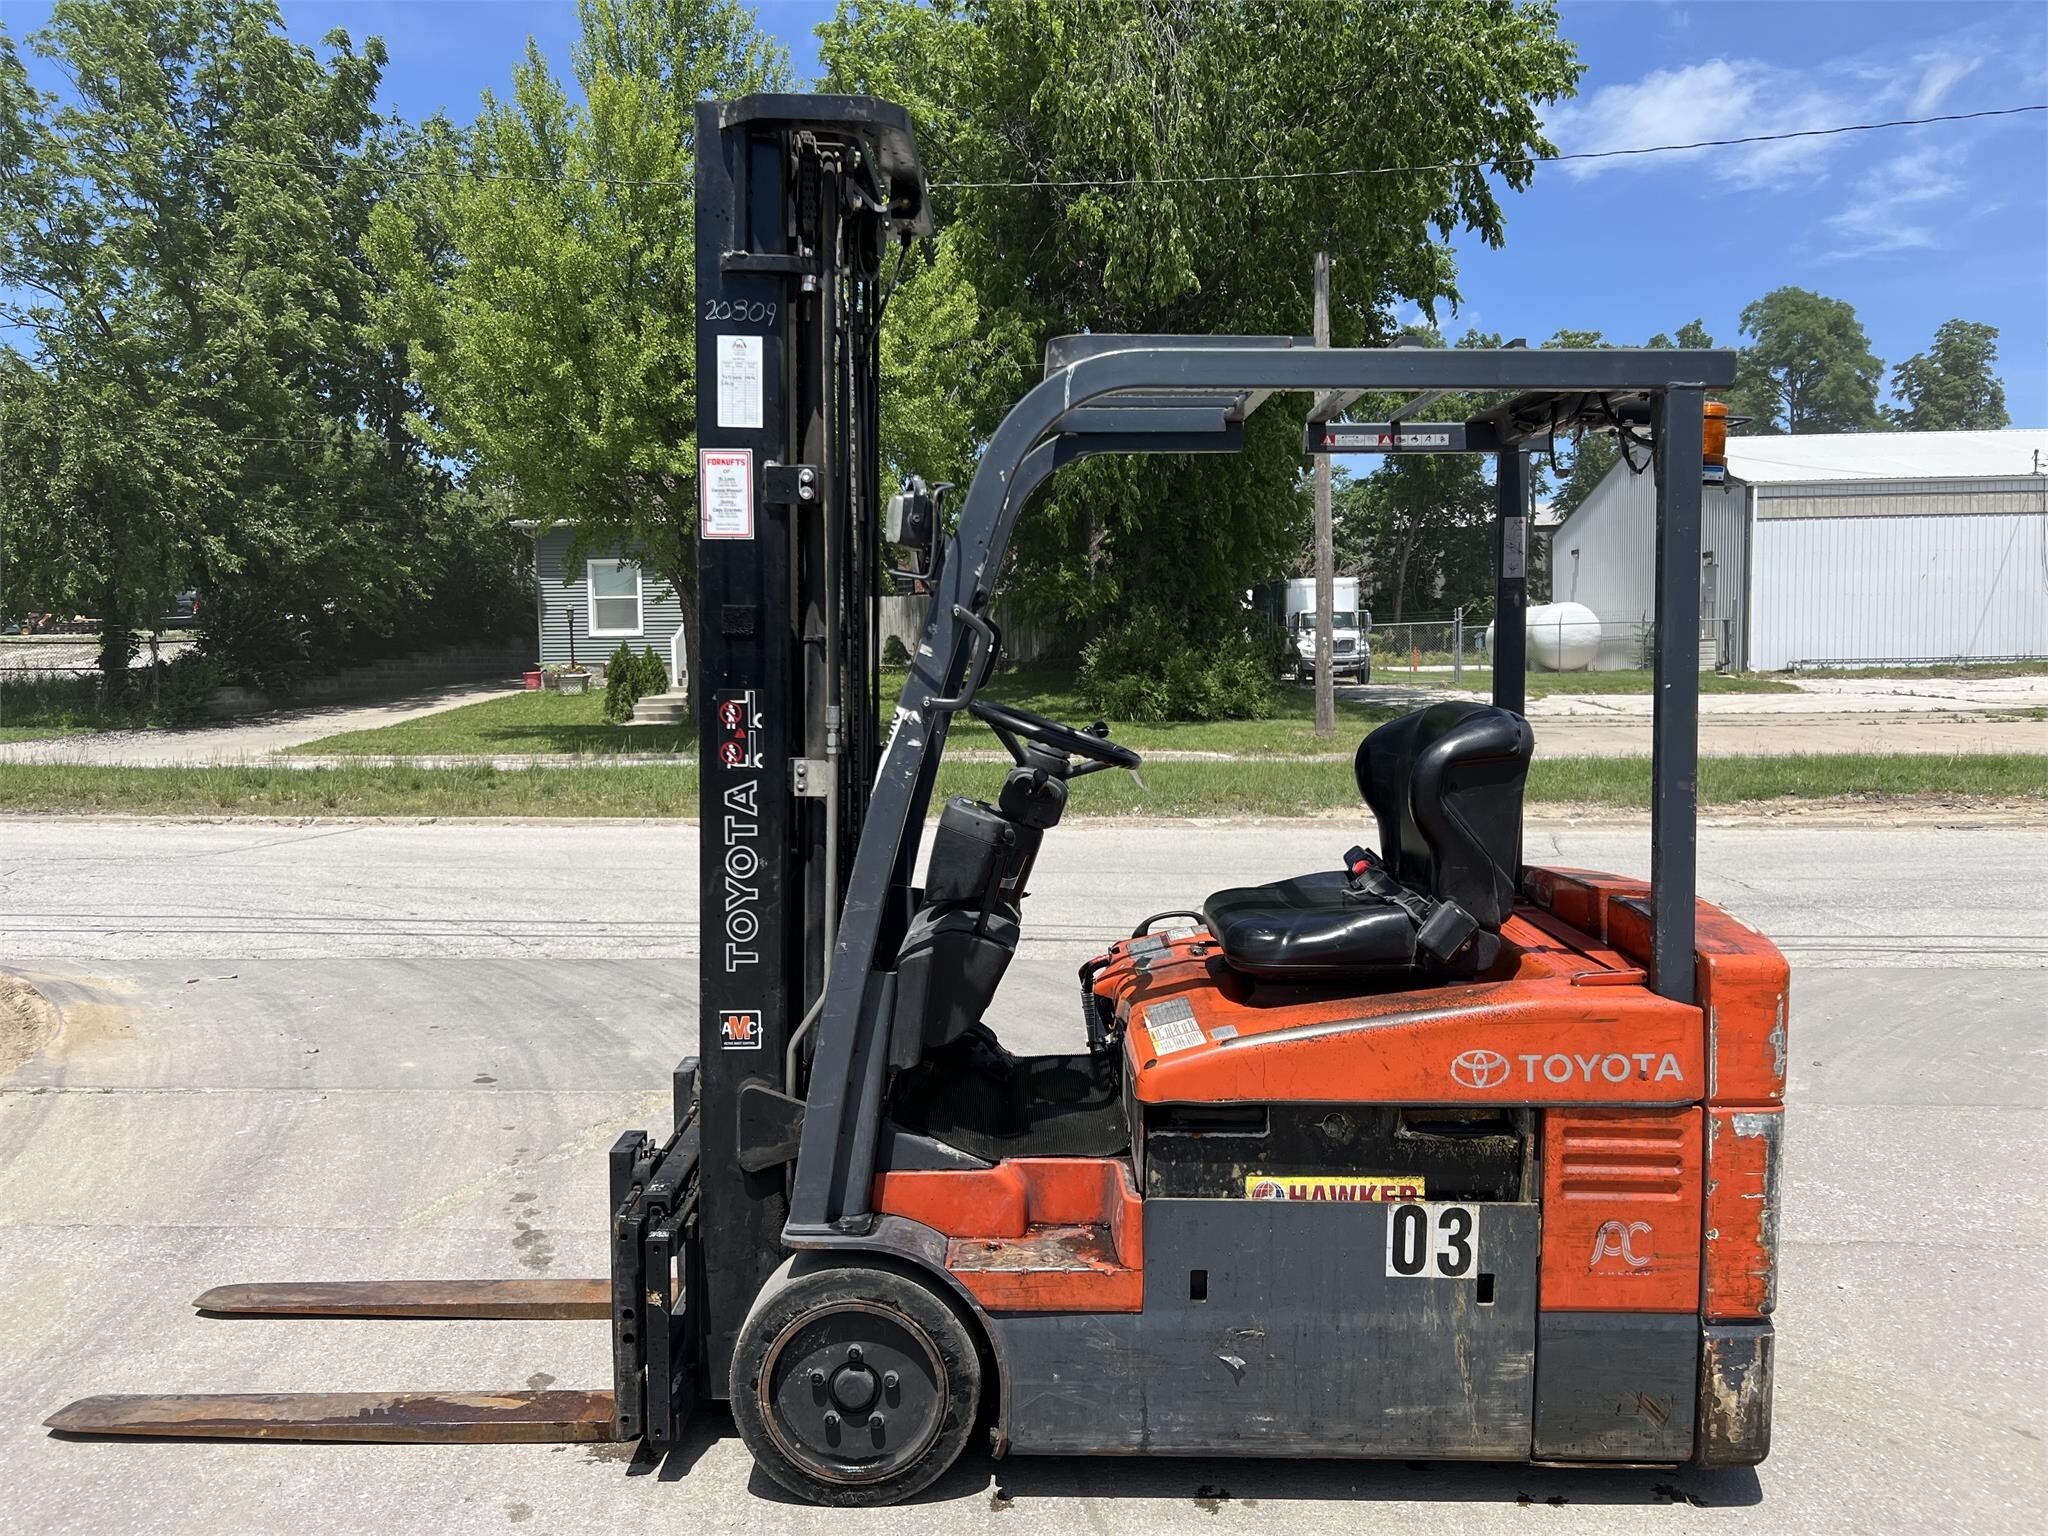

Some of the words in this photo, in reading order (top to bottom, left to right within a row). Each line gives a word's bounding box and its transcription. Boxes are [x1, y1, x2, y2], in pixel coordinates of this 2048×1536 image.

[724, 779, 758, 972] TOYOTA
[721, 1015, 758, 1040] AMC
[1518, 1053, 1684, 1083] TOYOTA
[1391, 1204, 1473, 1277] 03
